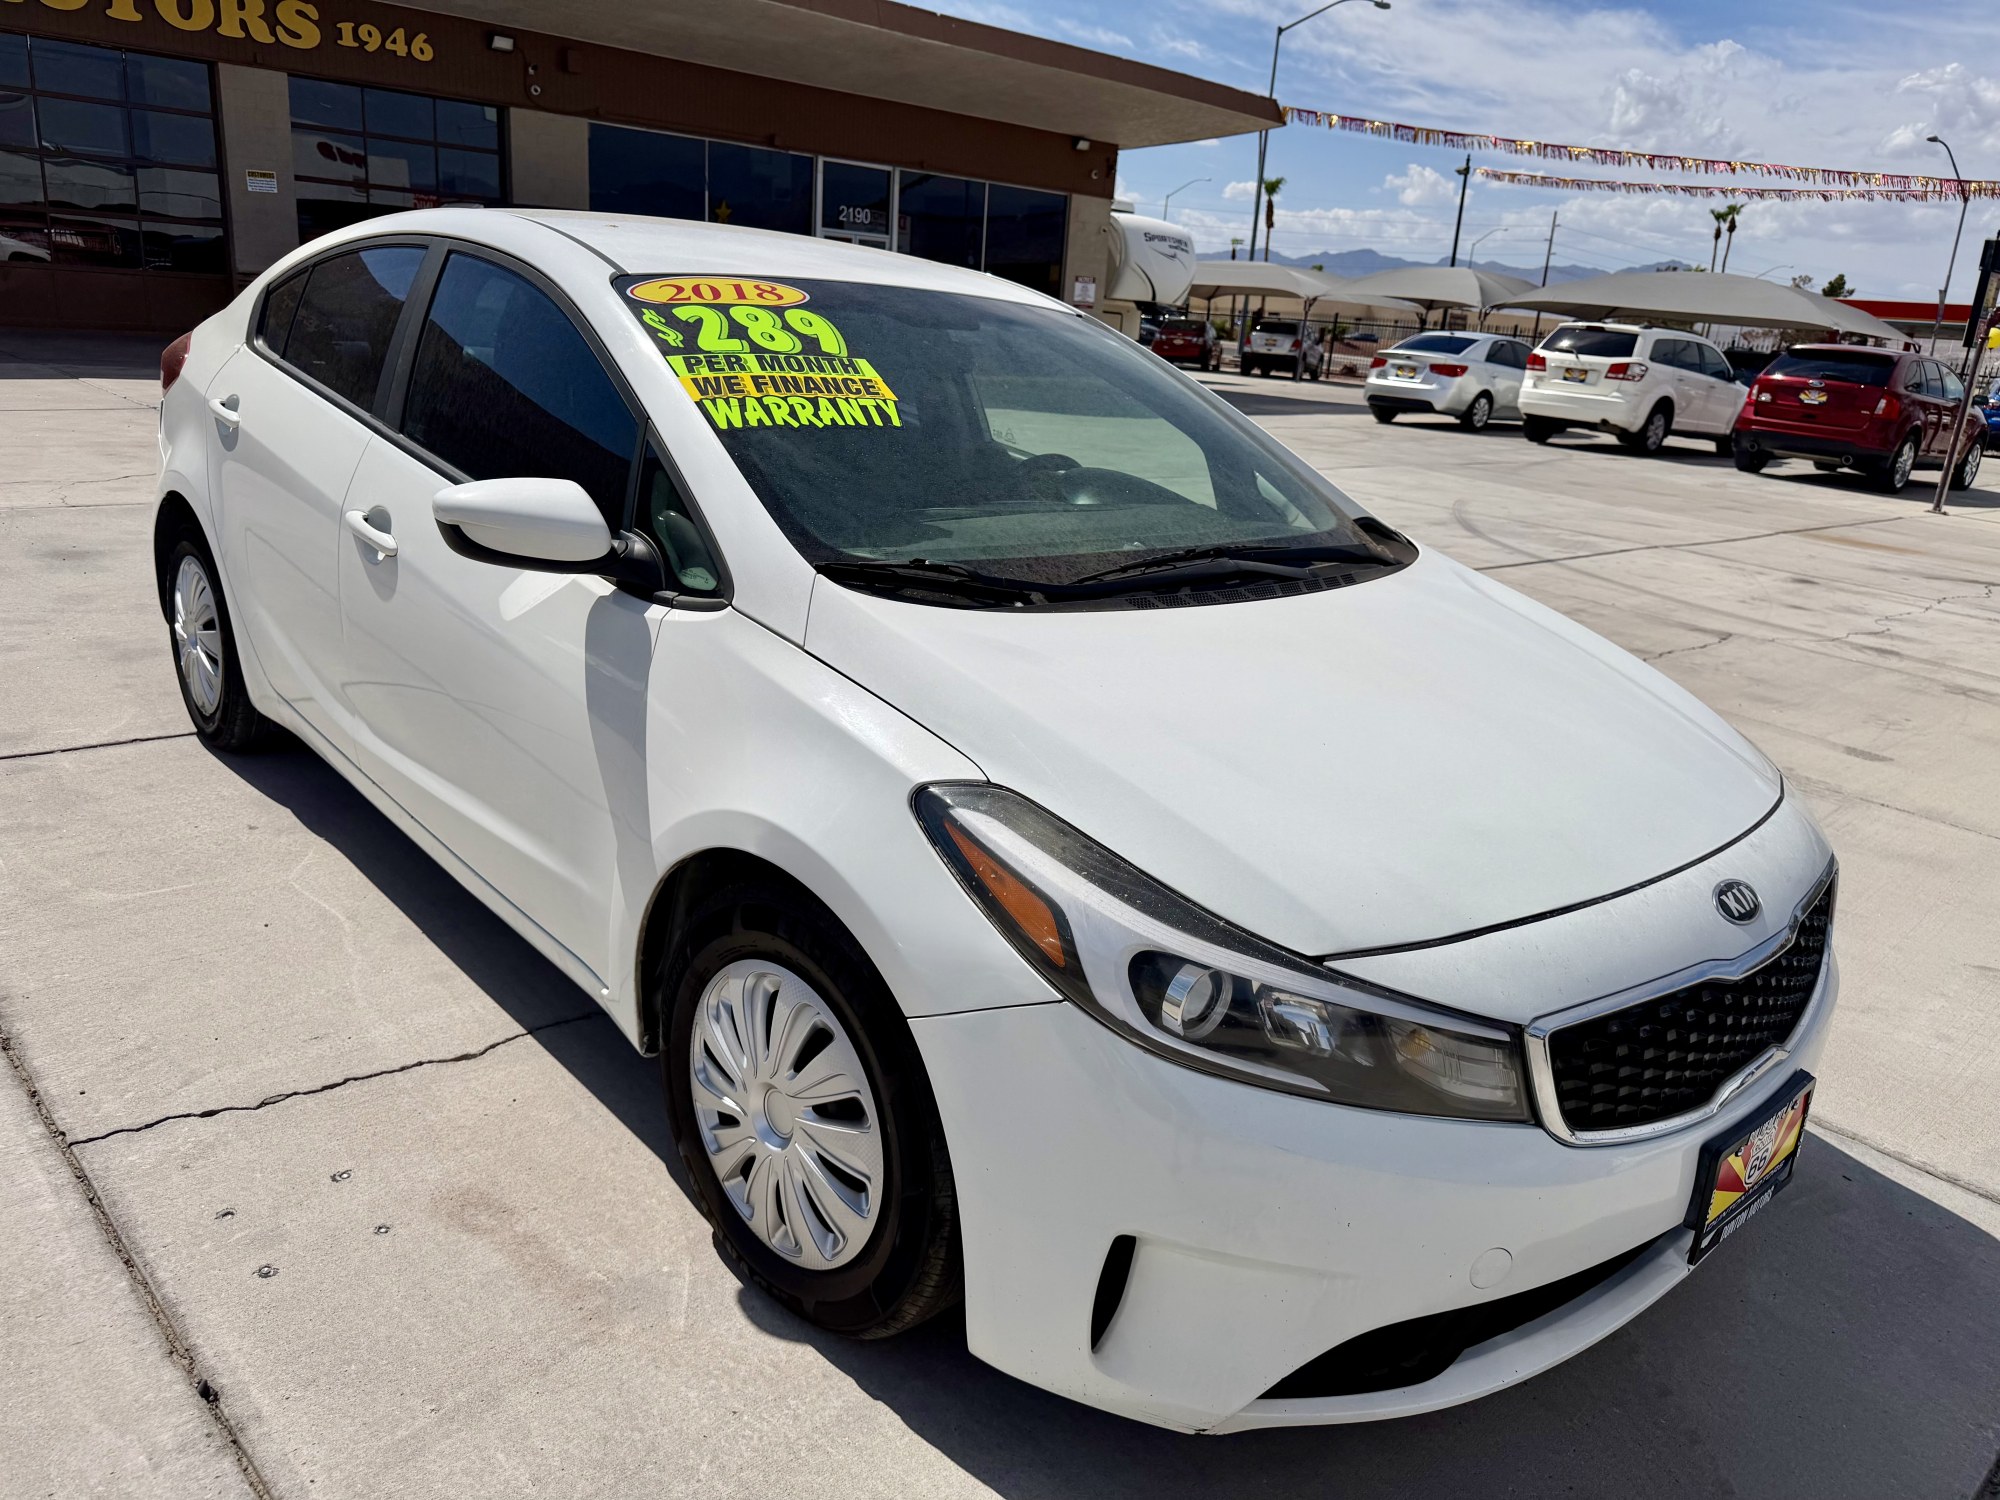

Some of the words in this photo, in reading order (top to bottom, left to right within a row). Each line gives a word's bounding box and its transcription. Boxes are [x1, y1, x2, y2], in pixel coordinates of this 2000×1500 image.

[0, 0, 321, 49] ORS
[336, 22, 434, 62] 1946
[839, 205, 871, 224] 2190
[658, 283, 785, 302] 2018
[641, 305, 848, 357] $289
[682, 354, 747, 375] PER
[754, 355, 863, 376] MONTH
[691, 375, 748, 396] WE
[751, 375, 882, 397] FINANCE
[701, 396, 902, 430] WARRANTY
[1720, 885, 1758, 917] KIA
[1747, 1147, 1770, 1180] 66
